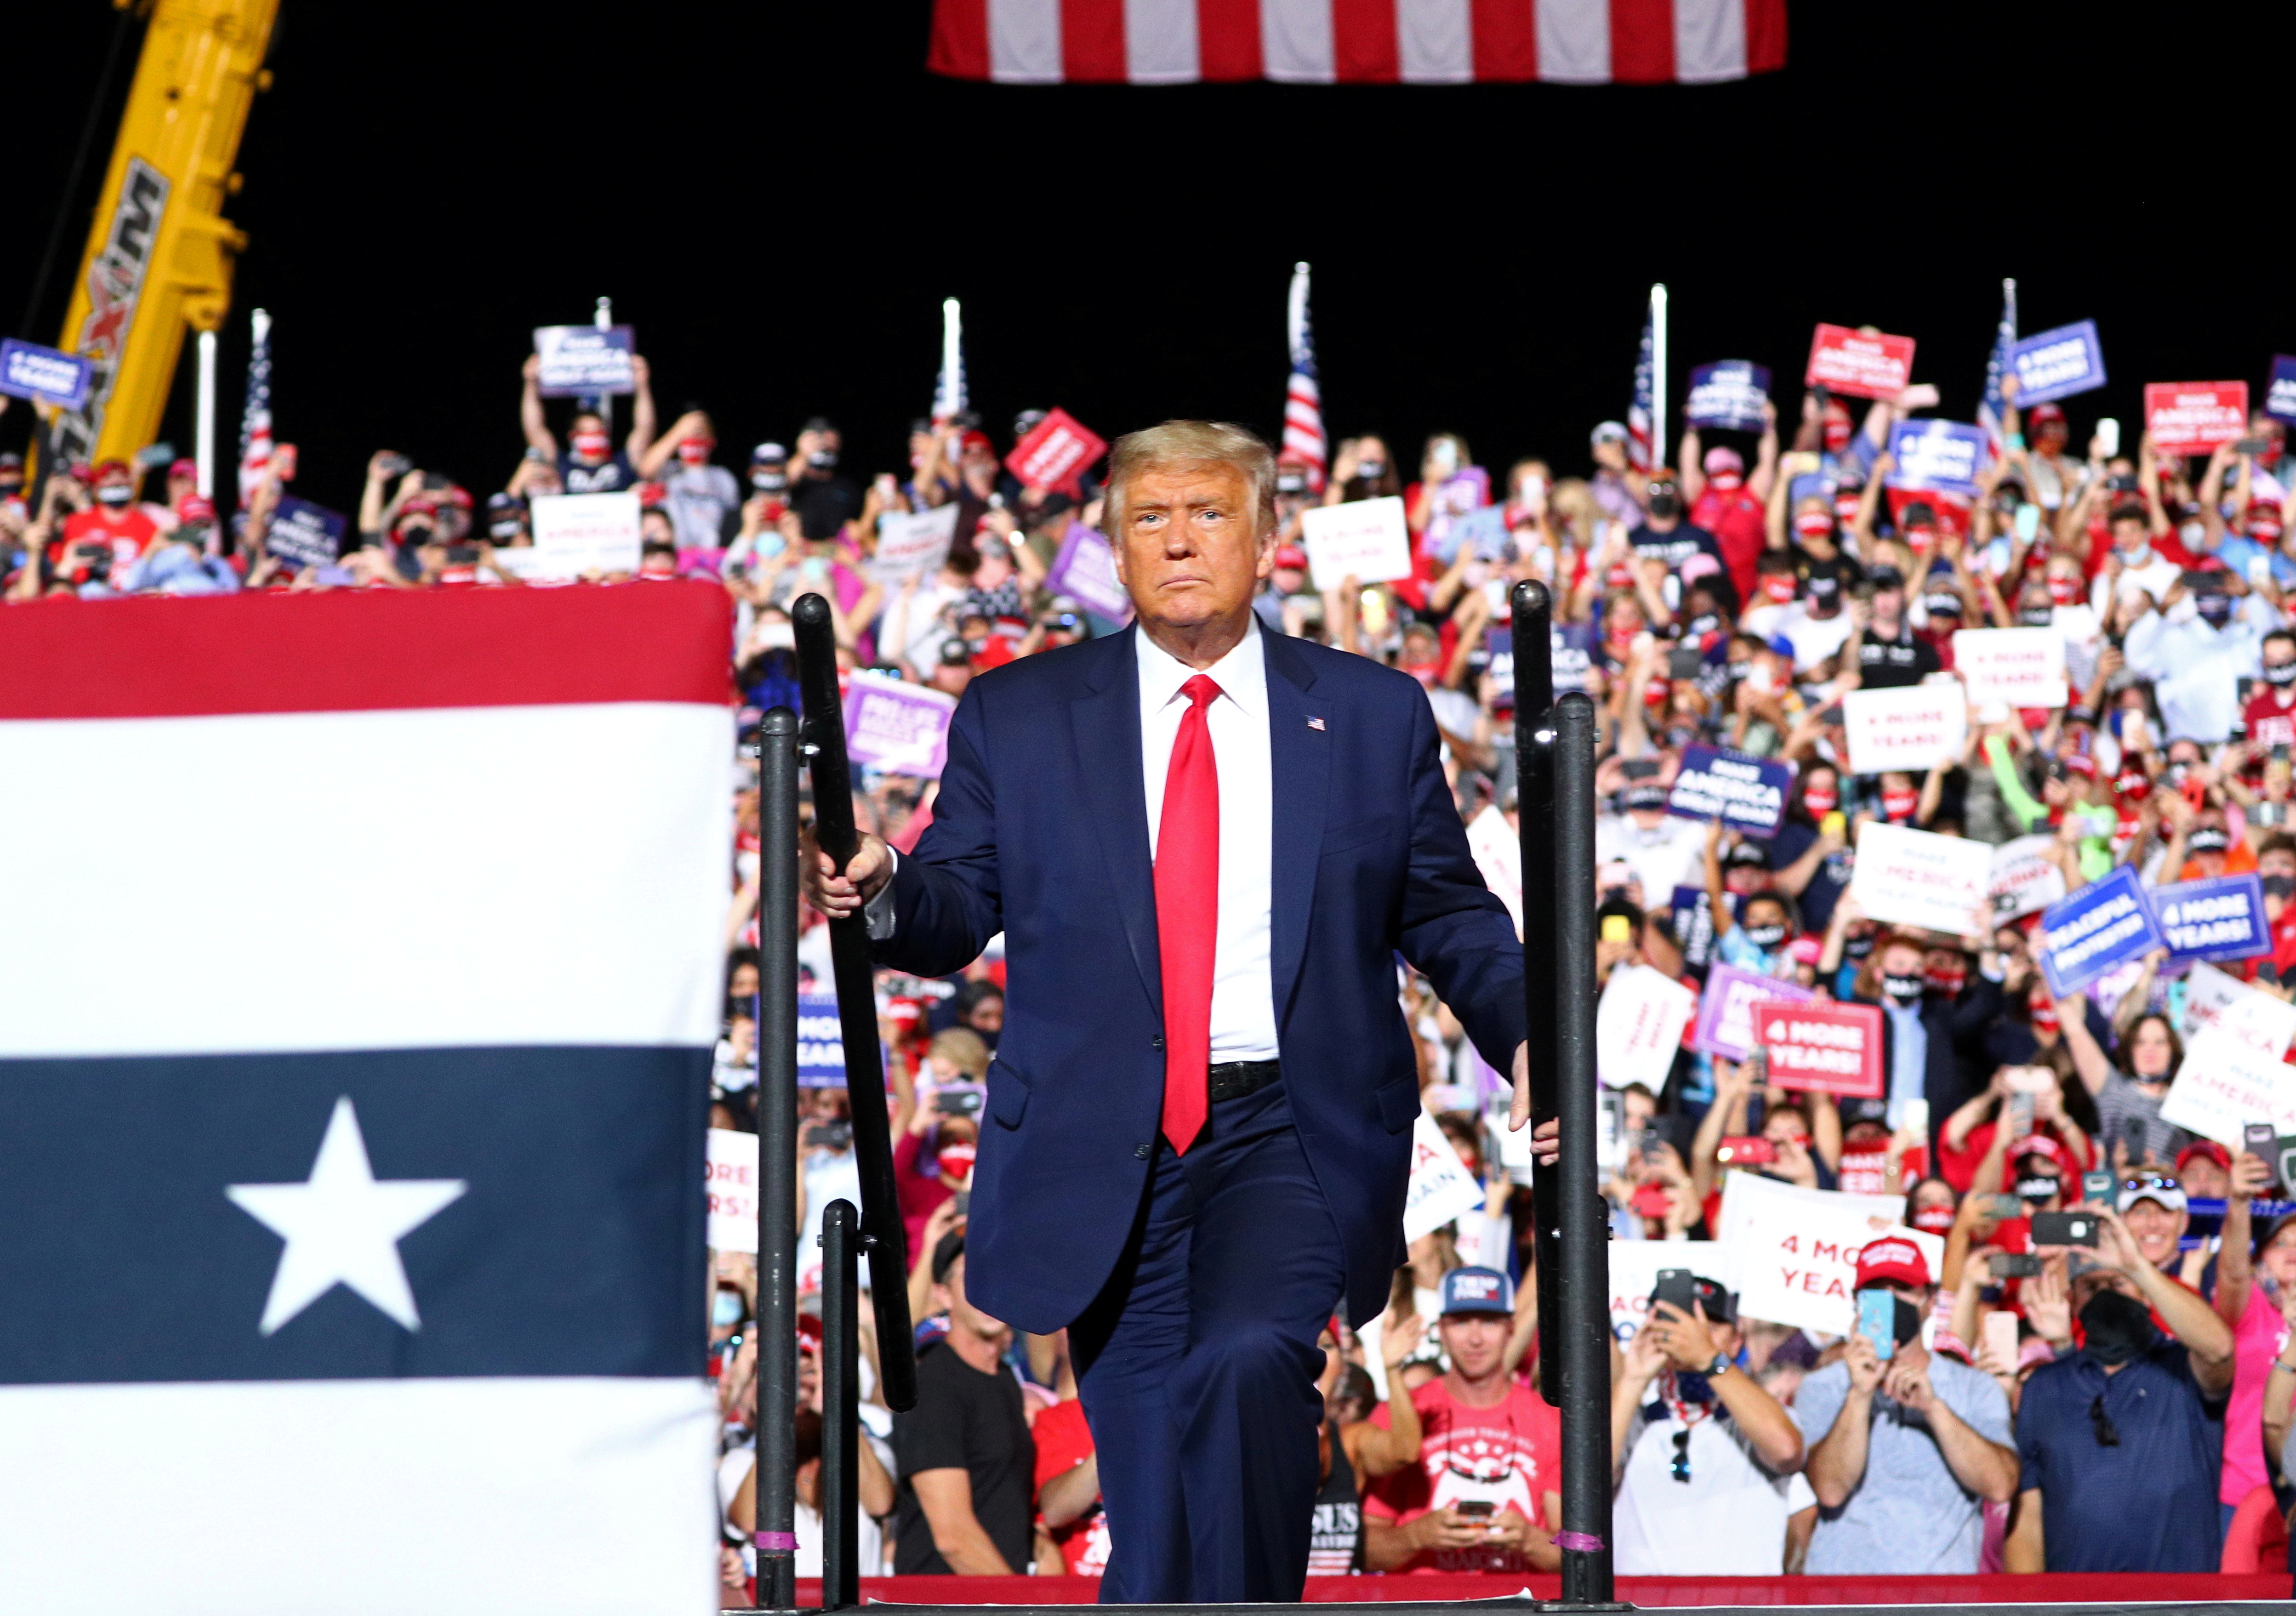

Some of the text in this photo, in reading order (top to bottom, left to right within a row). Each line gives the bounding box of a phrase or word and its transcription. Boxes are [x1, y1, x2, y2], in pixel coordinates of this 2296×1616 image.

[1676, 769, 1781, 810] AMERICA
[2162, 893, 2250, 926] 4 MORE
[1767, 1019, 1863, 1050] 4 MORE
[1769, 1045, 1862, 1075] YEARS!
[1780, 1235, 1798, 1253] 4
[1813, 1240, 1863, 1267] MO
[1780, 1267, 1846, 1300] YEA
[1312, 1502, 1359, 1534] SUS
